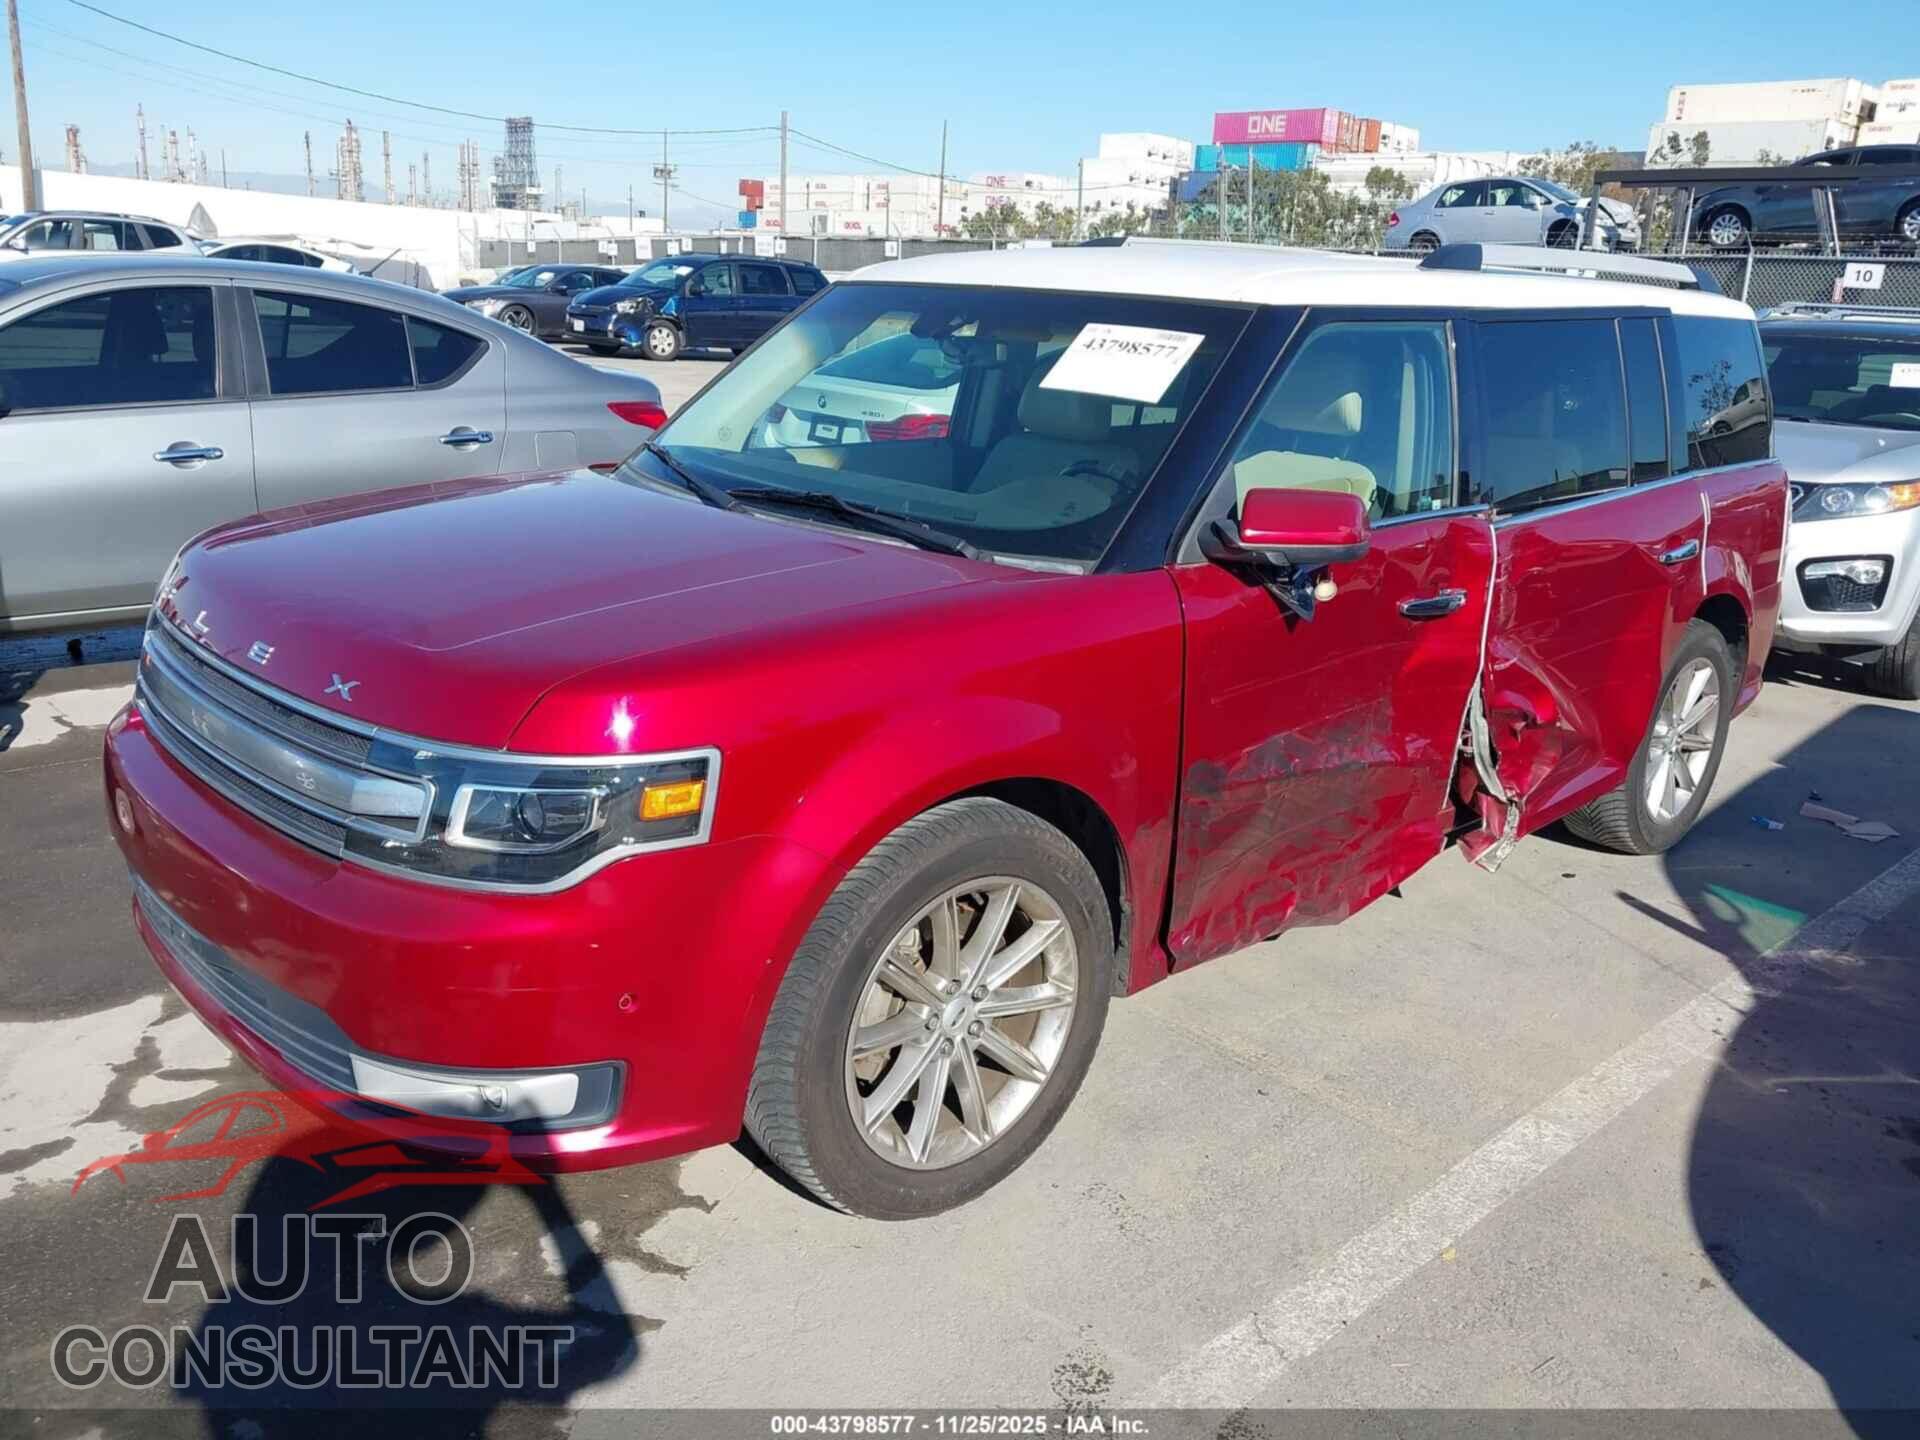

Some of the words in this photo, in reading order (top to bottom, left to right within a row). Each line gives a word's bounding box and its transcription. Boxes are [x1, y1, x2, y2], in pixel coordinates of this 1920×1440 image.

[1248, 114, 1287, 134] ONE
[986, 176, 1006, 187] ONE
[1855, 270, 1873, 282] 10
[1083, 338, 1178, 358] 43798577
